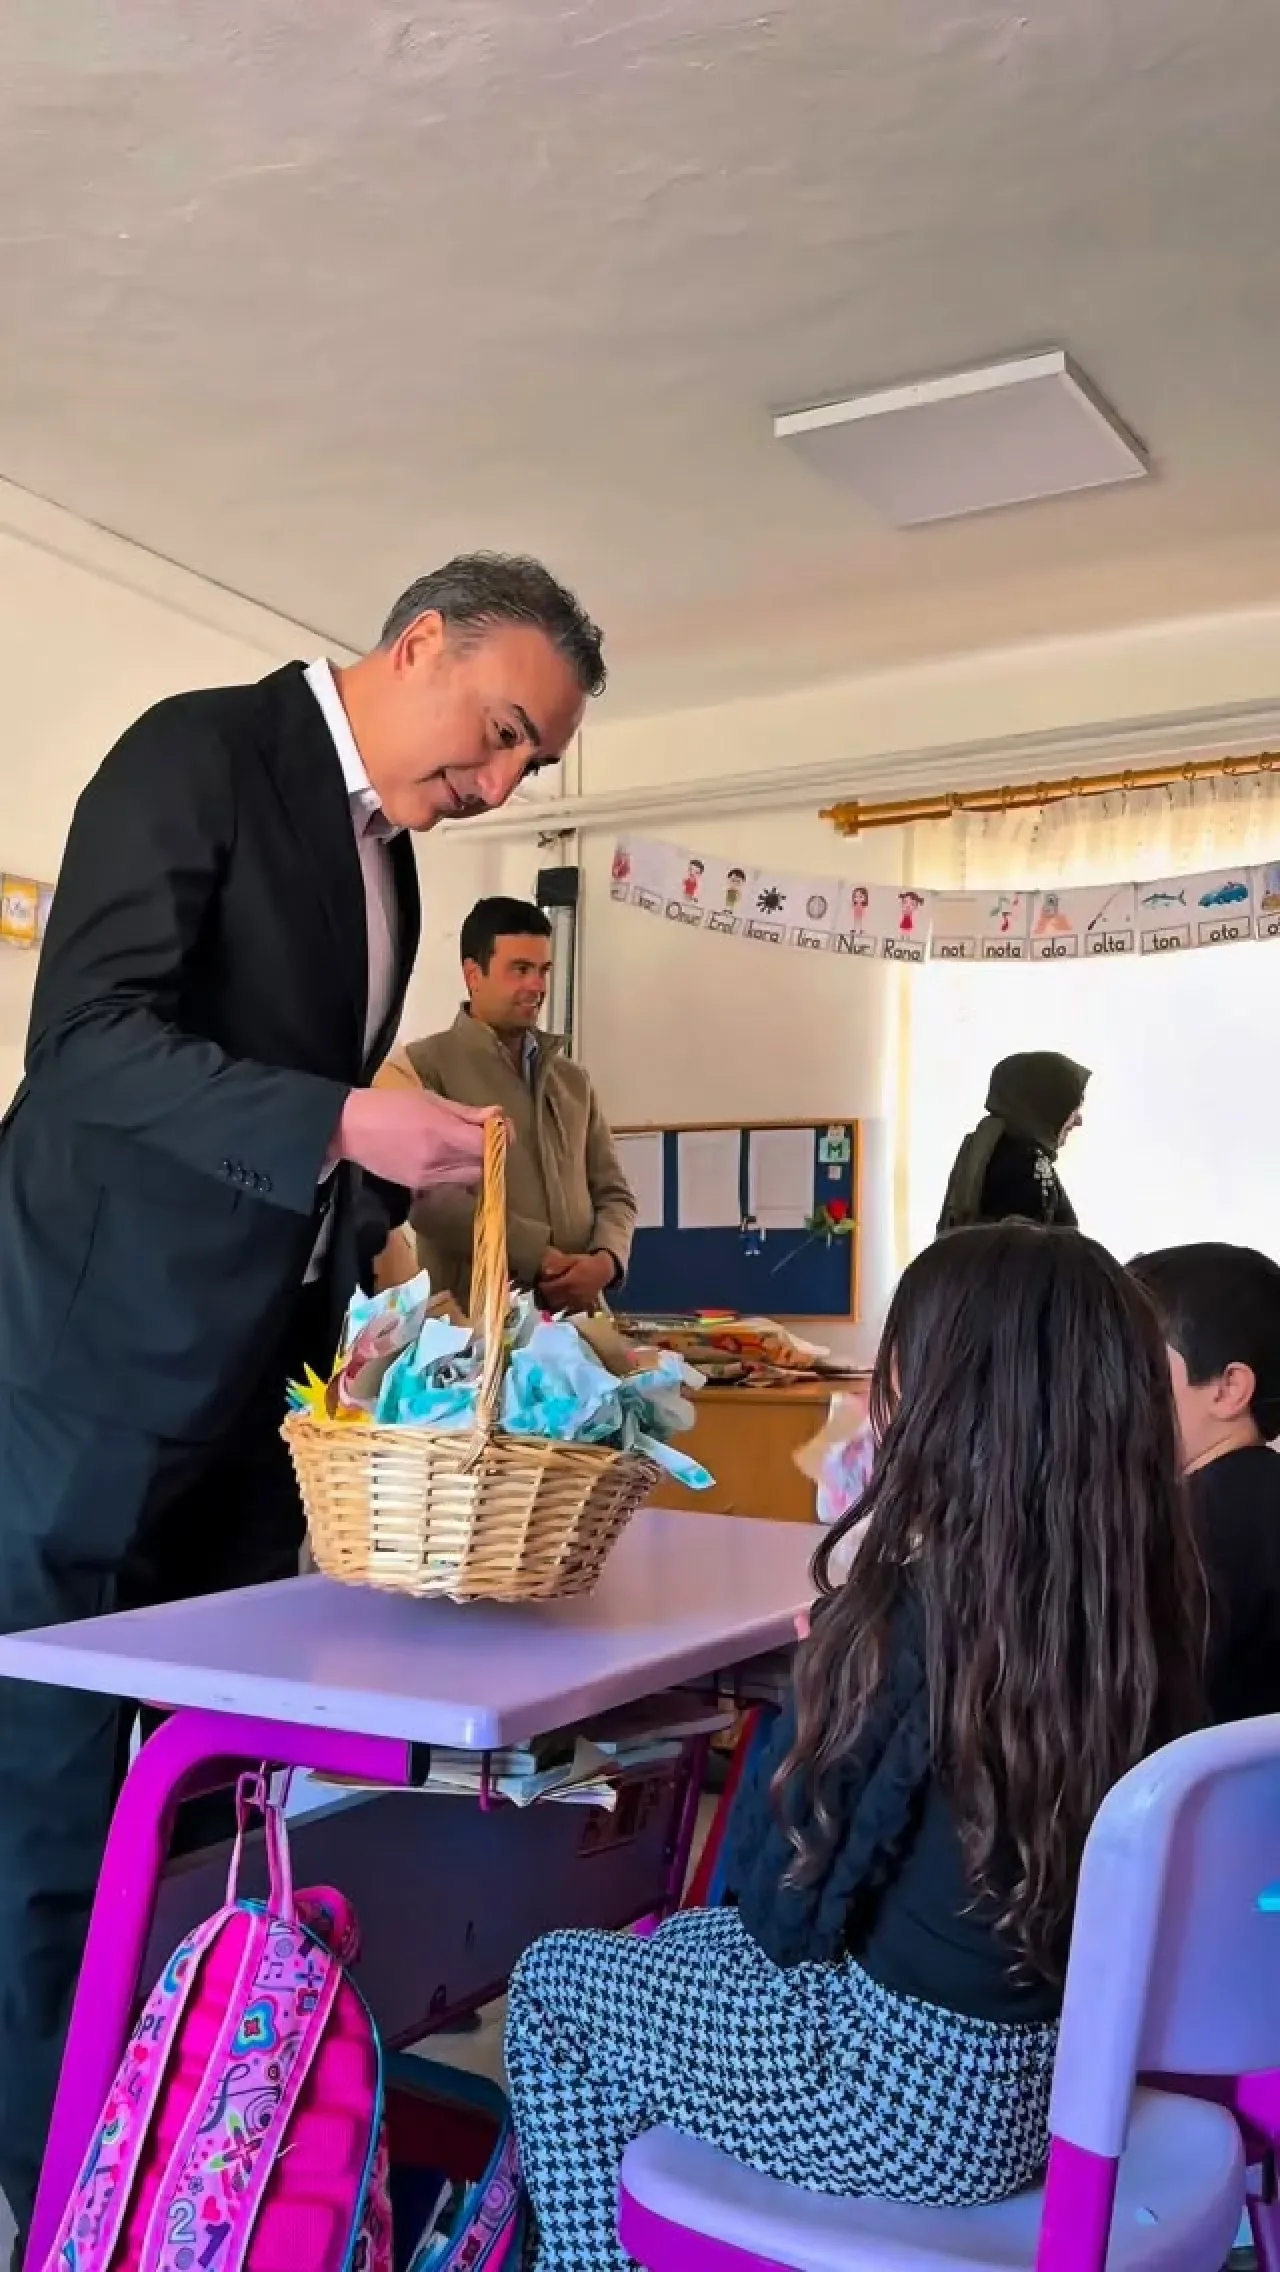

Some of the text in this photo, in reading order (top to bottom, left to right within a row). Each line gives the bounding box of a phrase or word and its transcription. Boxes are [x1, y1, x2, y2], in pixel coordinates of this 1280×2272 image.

[748, 919, 779, 943] kara
[838, 931, 871, 955] Nur
[883, 937, 921, 960] Rana
[941, 942, 965, 958] not
[986, 941, 1021, 958] nota
[1093, 931, 1125, 954] olta
[1210, 923, 1239, 942] oto
[827, 1141, 843, 1159] M
[167, 2198, 197, 2245] 2
